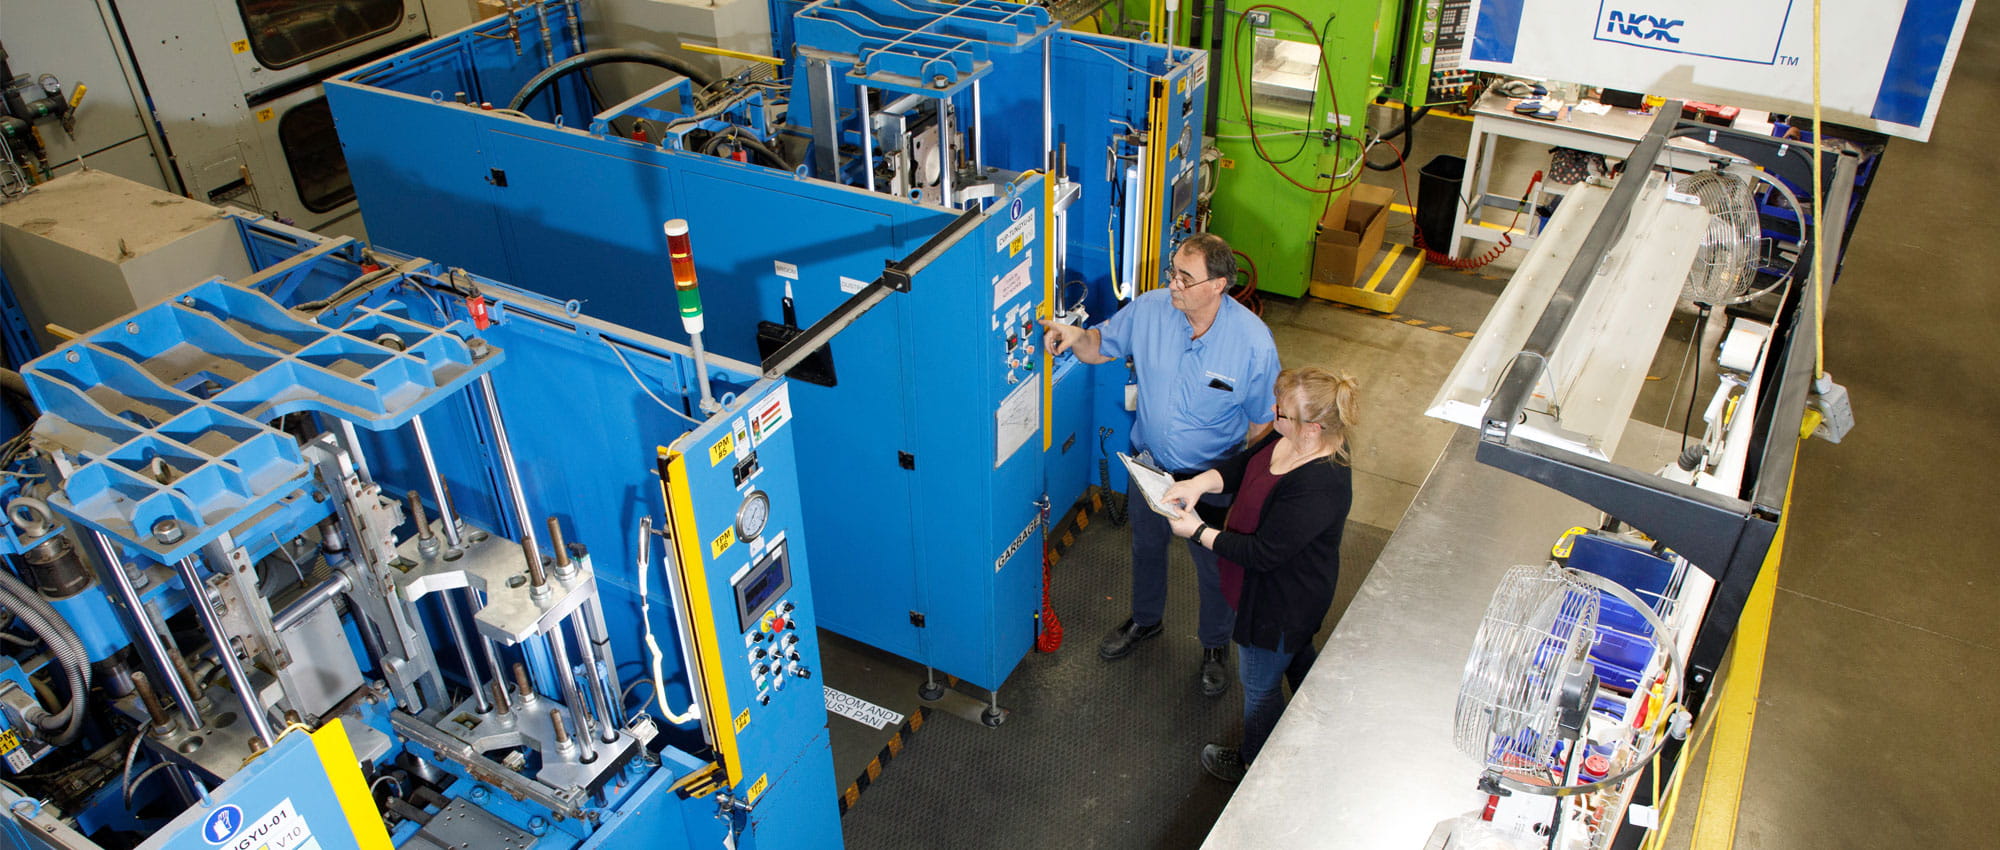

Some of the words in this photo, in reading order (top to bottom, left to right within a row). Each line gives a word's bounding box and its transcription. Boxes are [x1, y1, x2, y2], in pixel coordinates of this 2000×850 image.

[1607, 10, 1684, 43] NOK
[1780, 56, 1799, 66] TM
[713, 436, 730, 454] TPM
[718, 449, 728, 459] #5
[715, 530, 731, 547] TPM
[998, 518, 1040, 568] GARBAGE
[751, 777, 764, 793] TPM
[276, 826, 301, 848] V10
